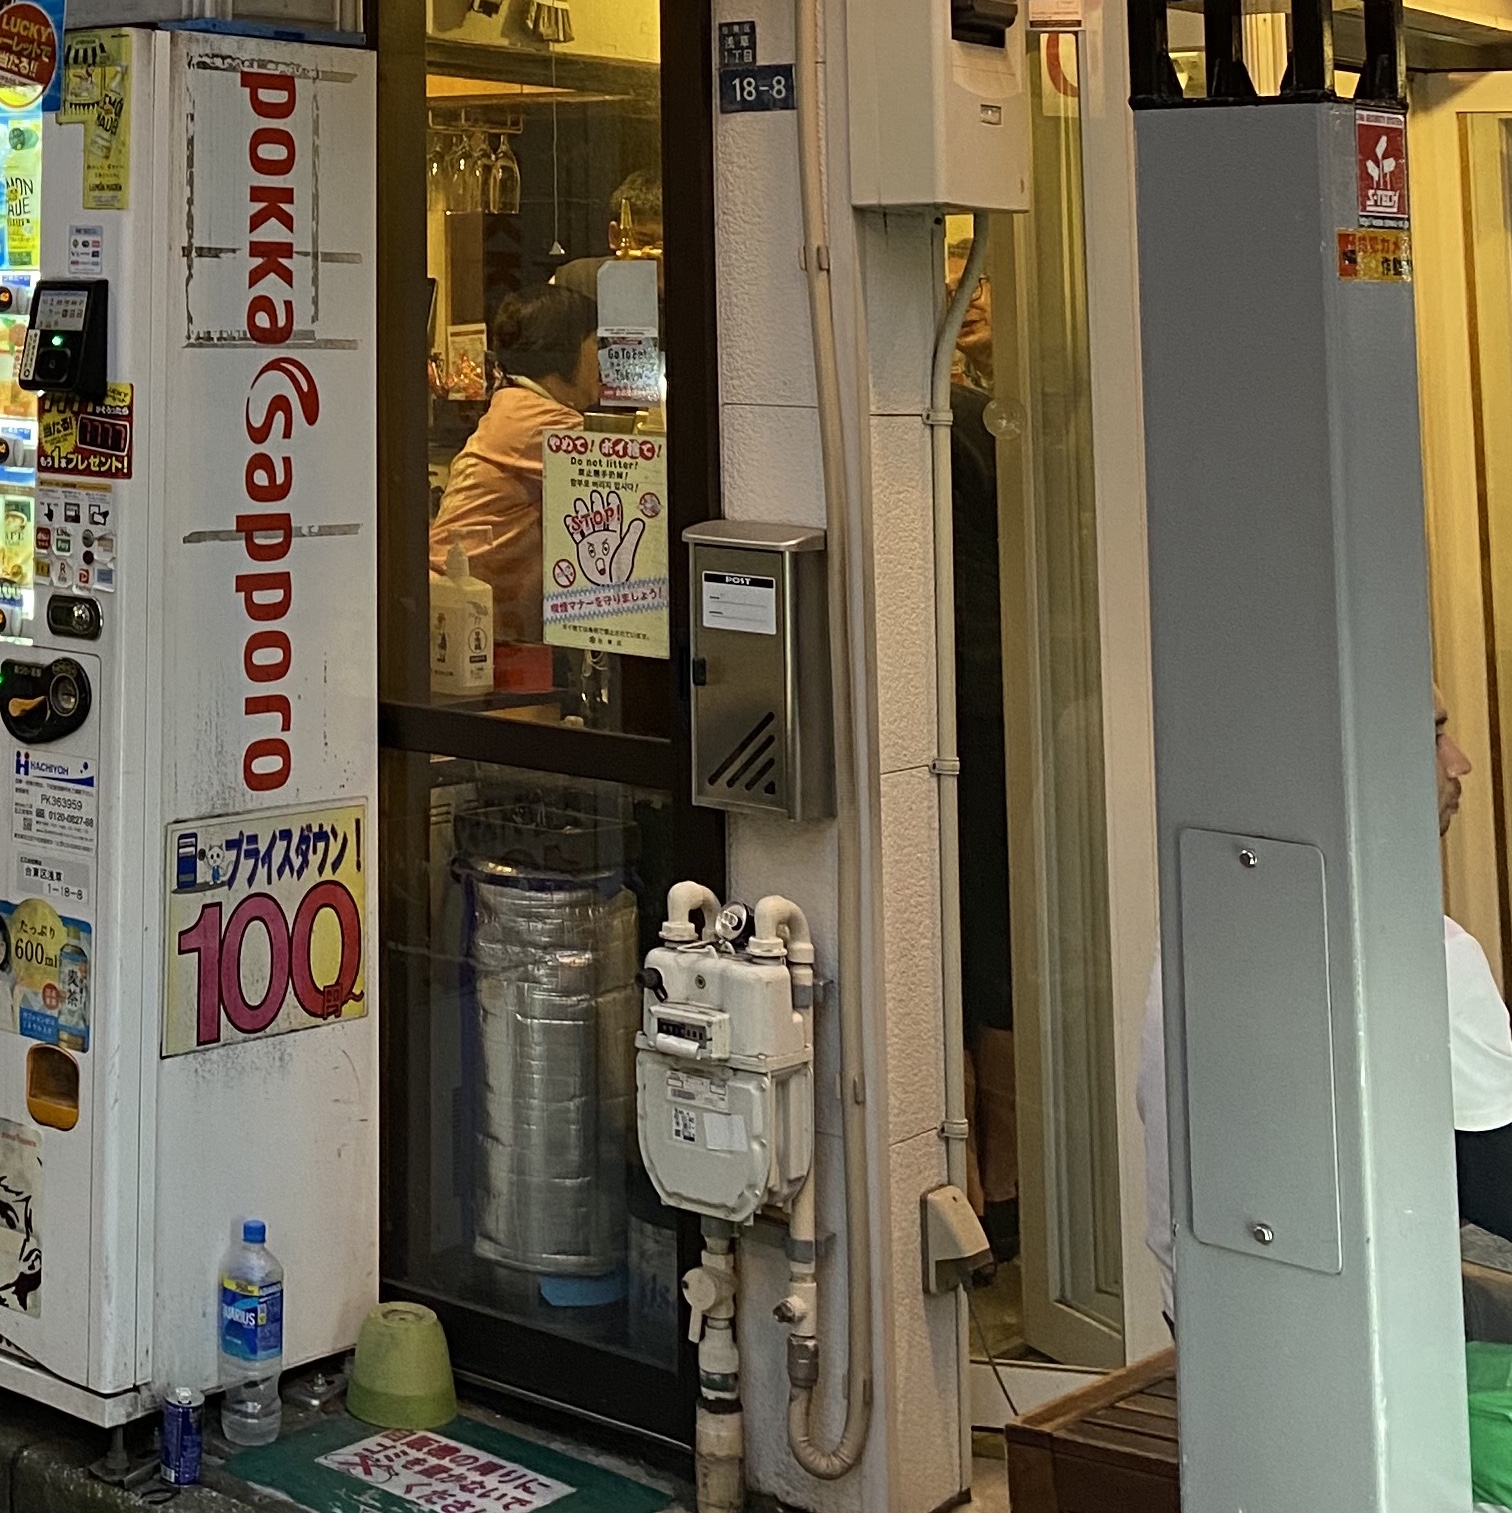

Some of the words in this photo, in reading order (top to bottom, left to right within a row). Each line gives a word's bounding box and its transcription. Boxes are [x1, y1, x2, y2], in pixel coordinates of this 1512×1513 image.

[1, 14, 51, 42] LUCKY
[731, 75, 787, 102] 18-8
[240, 71, 297, 345] pokka
[571, 457, 583, 466] Do
[586, 458, 603, 468] not
[570, 503, 622, 534] STOP!
[234, 394, 295, 792] sapporo
[725, 575, 751, 585] POST
[225, 818, 362, 891] プライスダウン!
[19, 919, 56, 940] たっぷり
[14, 939, 58, 969] 600ml
